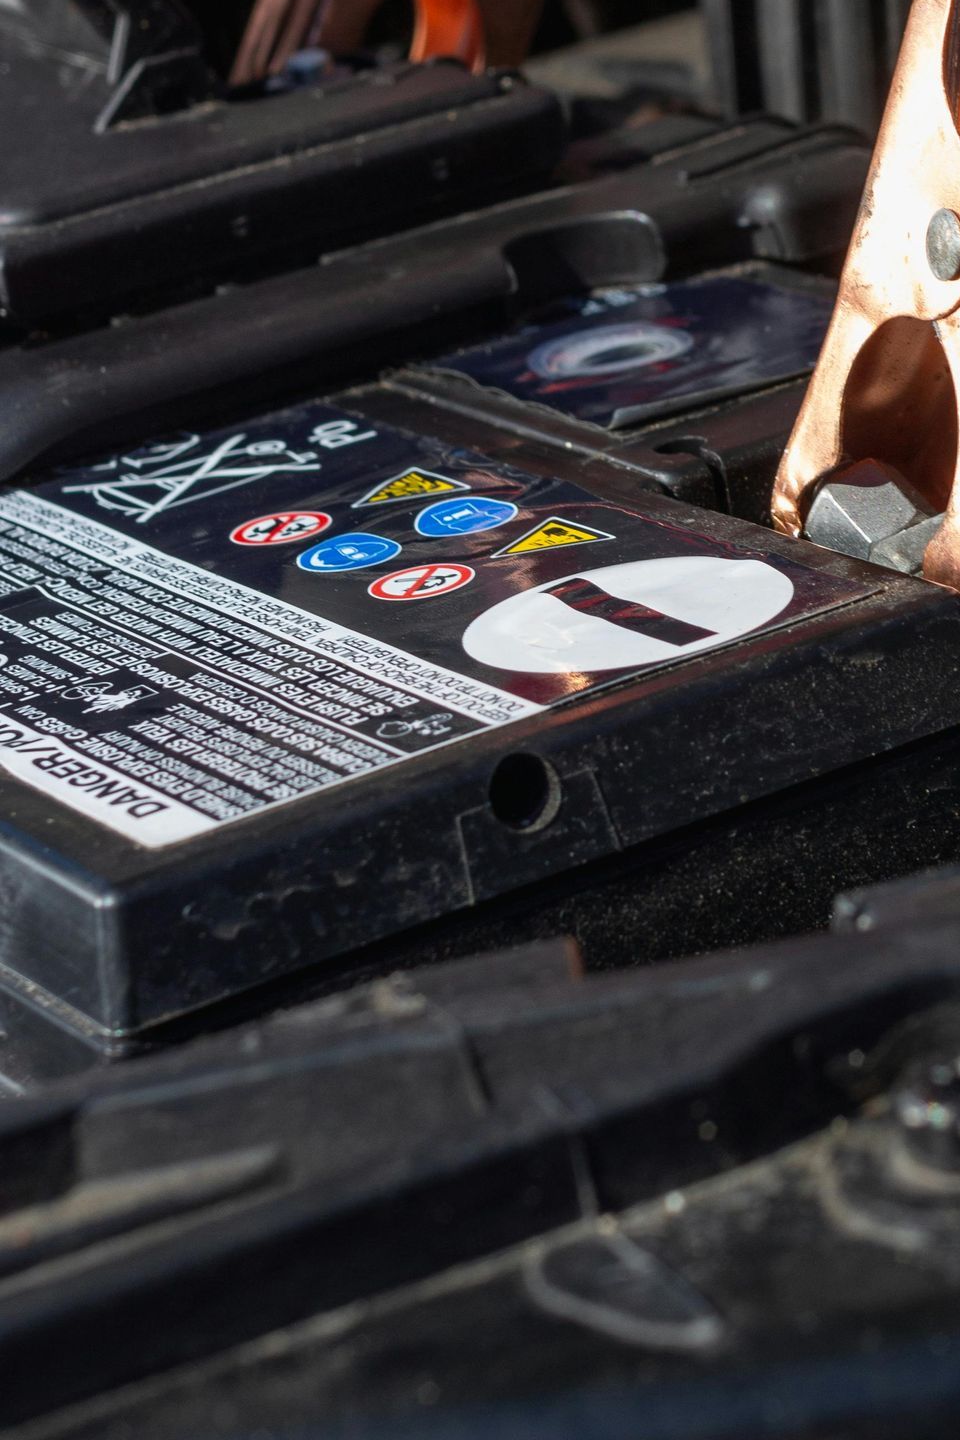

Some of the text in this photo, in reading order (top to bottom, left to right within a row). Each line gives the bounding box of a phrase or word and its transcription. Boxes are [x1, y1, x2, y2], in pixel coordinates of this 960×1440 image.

[308, 420, 378, 449] Pb
[97, 568, 150, 592] AGUA,
[167, 578, 198, 591] DES
[131, 584, 177, 603] CON
[220, 587, 252, 600] PAS
[239, 595, 266, 606] NE
[80, 598, 123, 616] GET
[222, 601, 247, 611] LA
[234, 606, 261, 617] DE
[105, 610, 166, 635] WATER
[158, 596, 282, 648] INMEDIATAMENTE
[248, 612, 290, 629] HORS
[299, 619, 333, 634] PAS
[24, 614, 139, 666] ET LES FLAMMES
[51, 610, 160, 659] DEFENSE DE FUMER
[149, 629, 199, 650] WITH
[32, 638, 73, 655] LES
[227, 644, 257, 656] A
[264, 641, 319, 664] OJOS
[14, 653, 76, 681] SMOKING
[51, 648, 114, 675] ÉVITER
[180, 643, 286, 688] IMMEDIATELY
[238, 649, 293, 672] YEUX
[300, 657, 348, 677] LOS
[358, 658, 389, 671] OF
[380, 653, 425, 671] OPEN
[0, 662, 53, 688] FLAMES
[274, 665, 321, 684] LES
[375, 665, 425, 685] REACH
[411, 666, 448, 681] NOT
[432, 674, 465, 688] DO
[184, 671, 251, 700] CEGUERA
[267, 682, 325, 706] EYES
[302, 678, 376, 708] RINCER
[329, 670, 422, 708] ENJUAGUE
[411, 680, 446, 694] THE
[431, 688, 464, 701] OF
[449, 696, 488, 711] OUT
[471, 690, 508, 705] NOT
[494, 699, 527, 712] DO
[11, 703, 49, 721] CAN
[125, 661, 376, 773] CUBRA SUS OJOS GASES EXPLOSIVOS
[163, 702, 227, 730] AVEUGLE
[242, 699, 303, 725] DAÑOS
[306, 699, 371, 726] FLUSH
[356, 700, 397, 717] SE
[125, 718, 181, 744] YEUX
[149, 712, 216, 742] PEUVENT
[211, 724, 273, 751] RENDRE
[95, 728, 151, 753] INJURY
[161, 736, 207, 756] LES
[71, 735, 161, 777] EXPLOSIVE
[134, 747, 170, 762] OR
[256, 745, 292, 760] OU
[186, 748, 282, 791] PROTEGER
[139, 769, 198, 795] EYES
[174, 787, 247, 820] SHIELD
